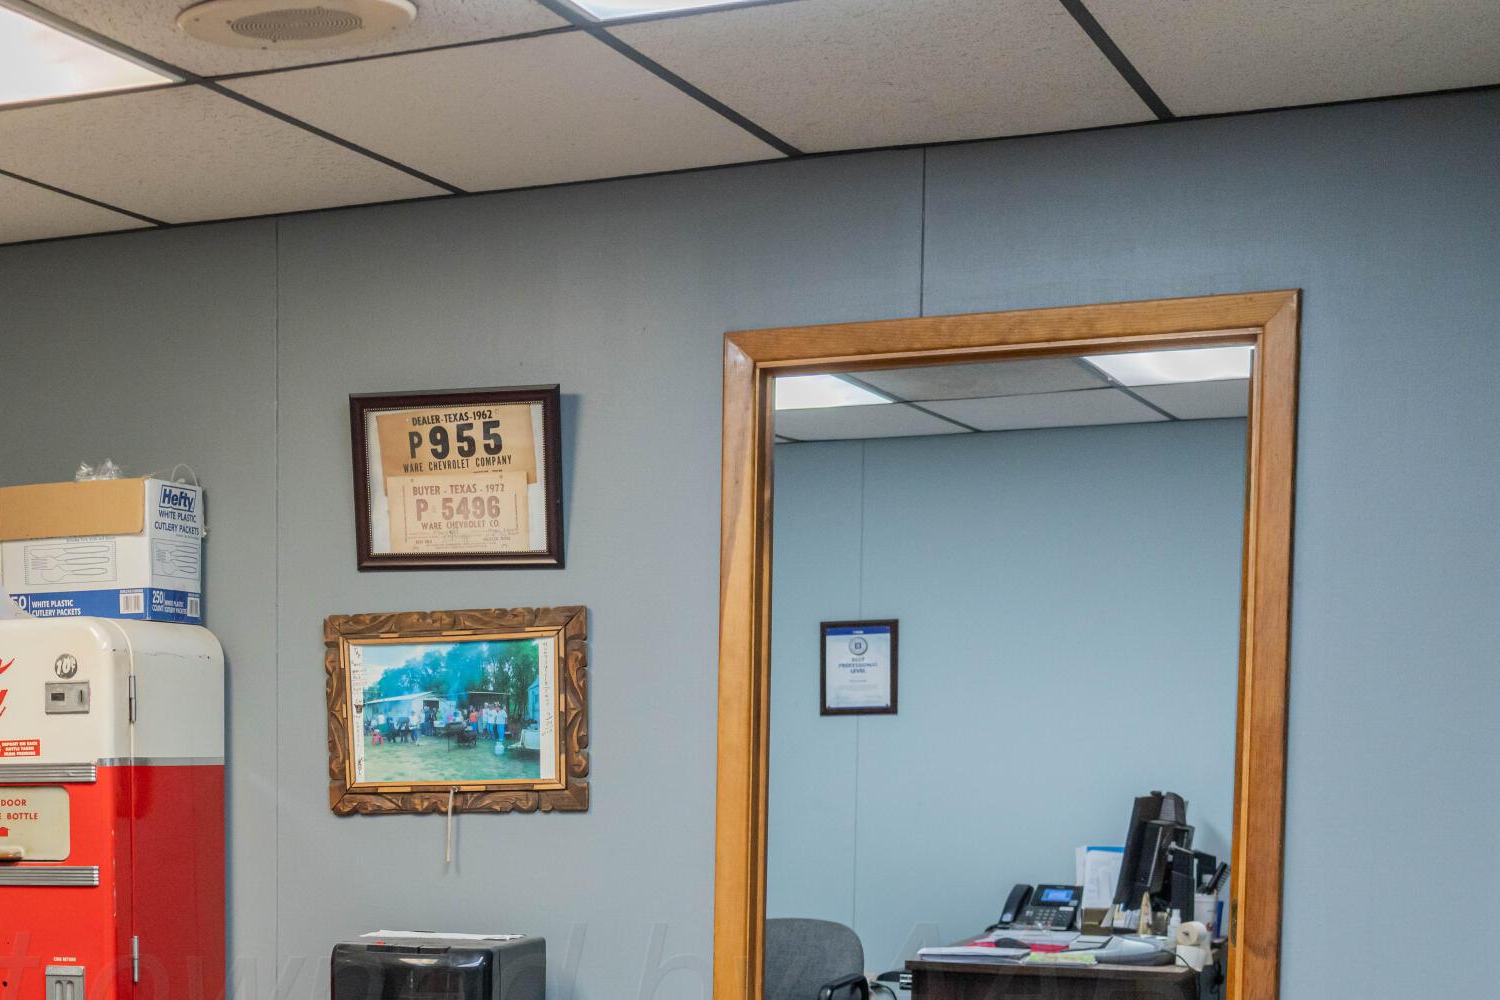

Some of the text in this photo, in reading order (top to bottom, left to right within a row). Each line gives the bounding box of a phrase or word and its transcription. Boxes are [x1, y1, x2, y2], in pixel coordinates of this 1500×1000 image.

[402, 455, 512, 473] WARE CHEVROLET COMPANY
[412, 485, 441, 496] BUYER
[449, 483, 477, 494] TEXAS
[485, 483, 505, 493] 1972
[161, 488, 194, 512] Hefty
[415, 495, 501, 521] P 5496
[158, 510, 197, 523] WHITE PLASTIC
[154, 521, 200, 536] CUTLERY PACKETS
[421, 521, 442, 530] WARE
[446, 519, 485, 529] CHEVROLET
[152, 590, 164, 604] 250
[31, 599, 74, 609] WHITE PLASTIC
[31, 608, 56, 617] CUTLERY
[56, 607, 81, 617] PACKETS
[0, 799, 28, 807] DOOR
[6, 812, 39, 820] BOTTLE
